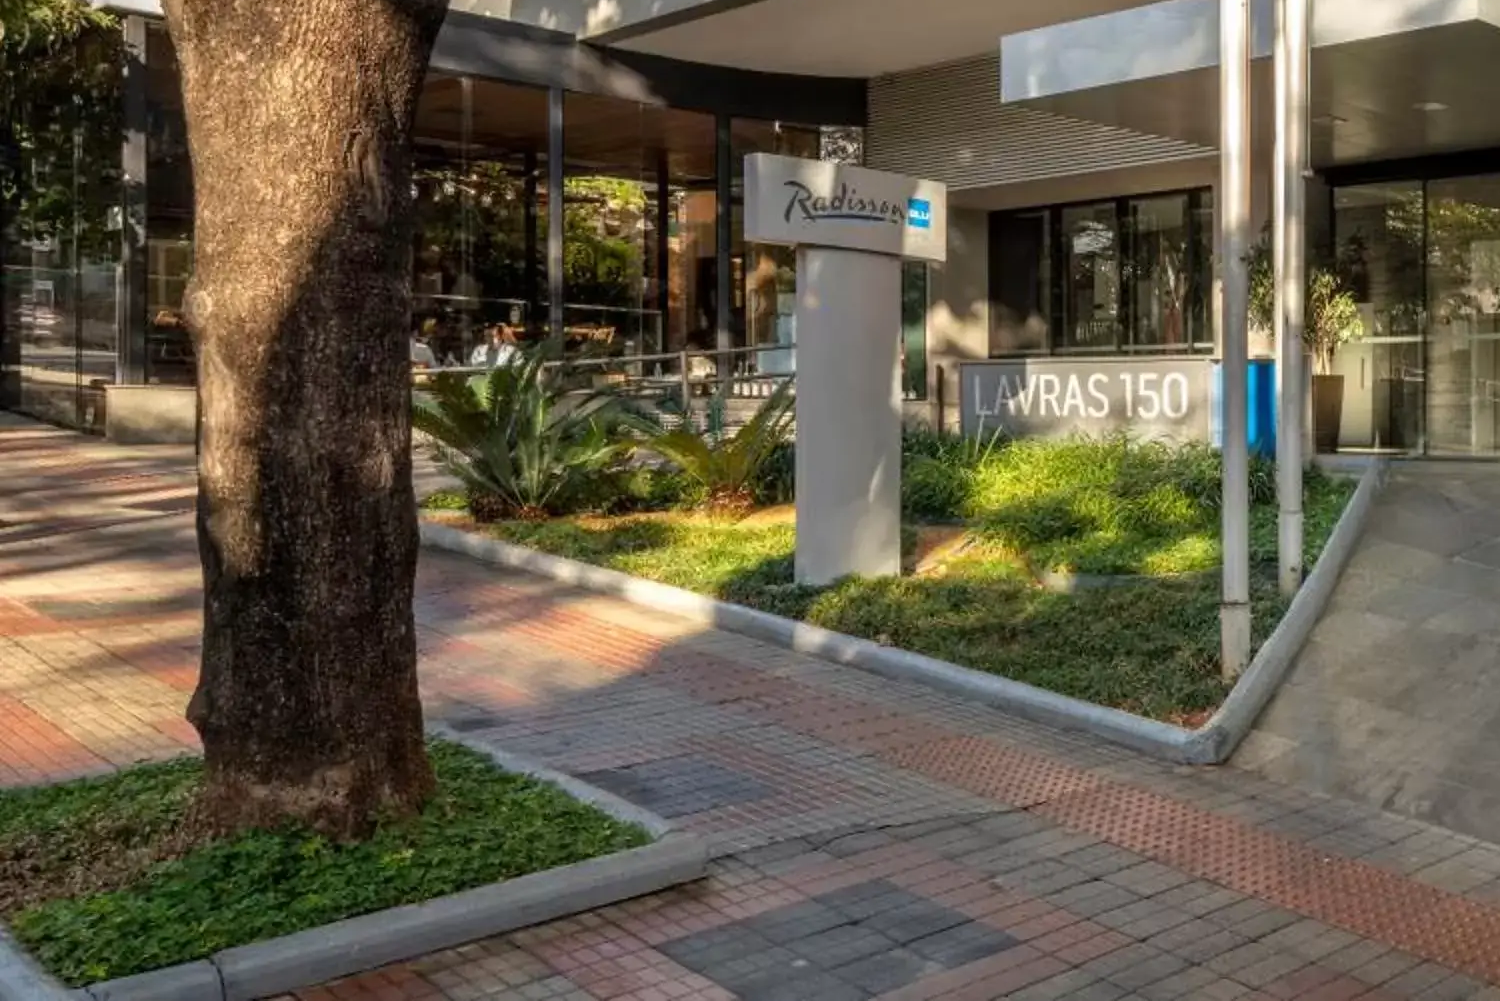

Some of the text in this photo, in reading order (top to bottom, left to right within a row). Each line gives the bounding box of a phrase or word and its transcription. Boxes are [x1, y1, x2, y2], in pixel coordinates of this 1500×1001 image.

[783, 180, 906, 224] Radisson
[974, 372, 1190, 420] LAVRAS 150
